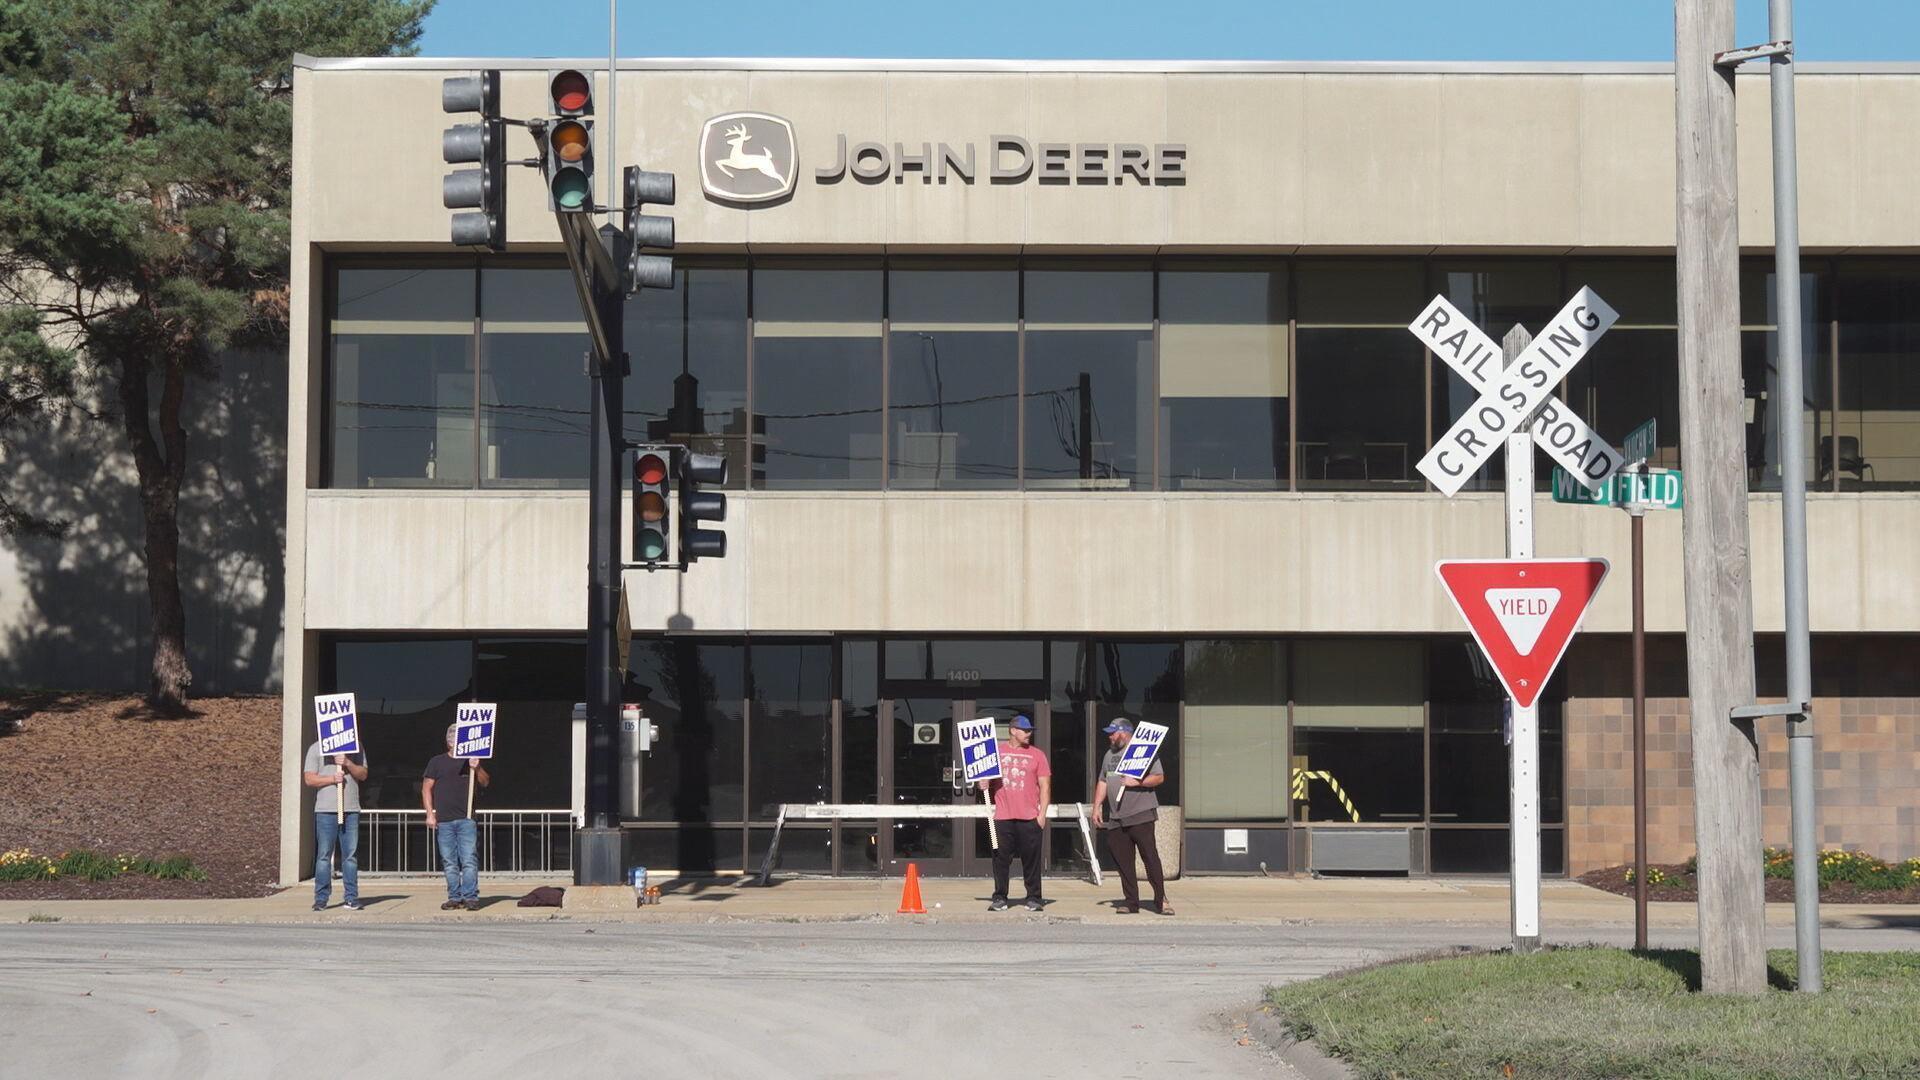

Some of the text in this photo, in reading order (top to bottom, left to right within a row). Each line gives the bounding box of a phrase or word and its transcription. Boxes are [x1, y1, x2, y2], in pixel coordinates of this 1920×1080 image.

[1421, 306, 1493, 383] RAIL
[1535, 402, 1612, 480] ROAD
[1437, 305, 1600, 477] CROSSING
[1499, 599, 1548, 616] YIELD
[948, 670, 980, 681] 1400
[318, 700, 351, 715] UAW
[460, 709, 493, 722] UAW
[330, 718, 345, 735] ON
[468, 726, 482, 740] ON
[961, 724, 992, 741] UAW
[1135, 727, 1162, 743] UAW
[322, 729, 355, 752] STRIKE
[457, 737, 491, 755] STRIKE
[973, 742, 987, 760] ON
[967, 753, 998, 778] STRIKE
[1119, 757, 1151, 772] STRIKE
